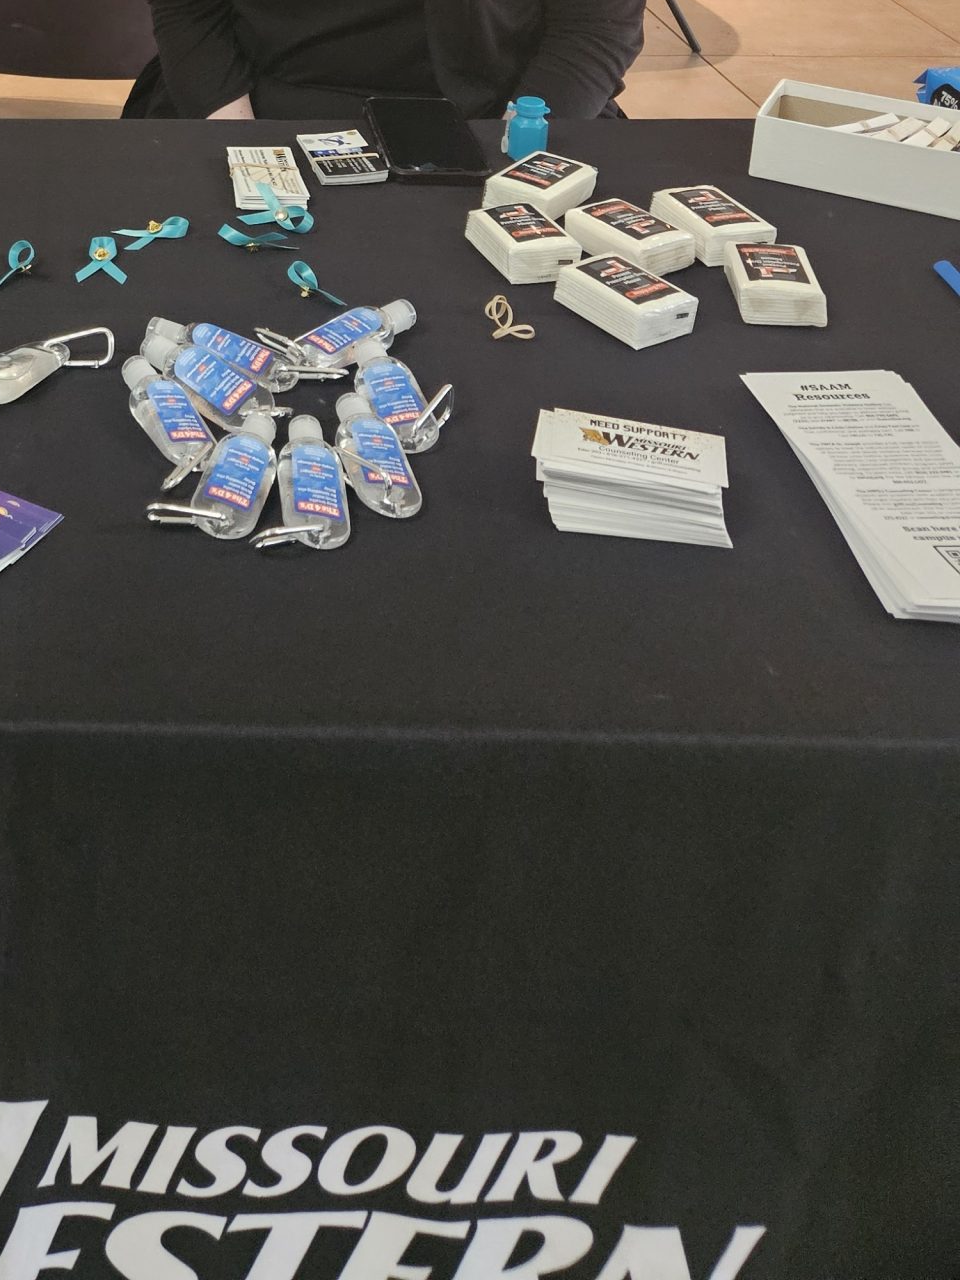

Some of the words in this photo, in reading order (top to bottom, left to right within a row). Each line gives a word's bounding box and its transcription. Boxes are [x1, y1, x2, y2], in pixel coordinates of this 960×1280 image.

[800, 383, 853, 392] #SAAM
[793, 392, 871, 402] Resources
[589, 419, 620, 431] NEED
[623, 424, 687, 442] SUPPORT?
[602, 431, 700, 461] WESTERN
[598, 445, 648, 461] Counseling
[650, 452, 680, 464] Center
[225, 491, 233, 500] 4
[232, 494, 249, 506] The
[300, 502, 313, 510] D's
[322, 505, 337, 515] The
[38, 1116, 637, 1205] MISSOURI
